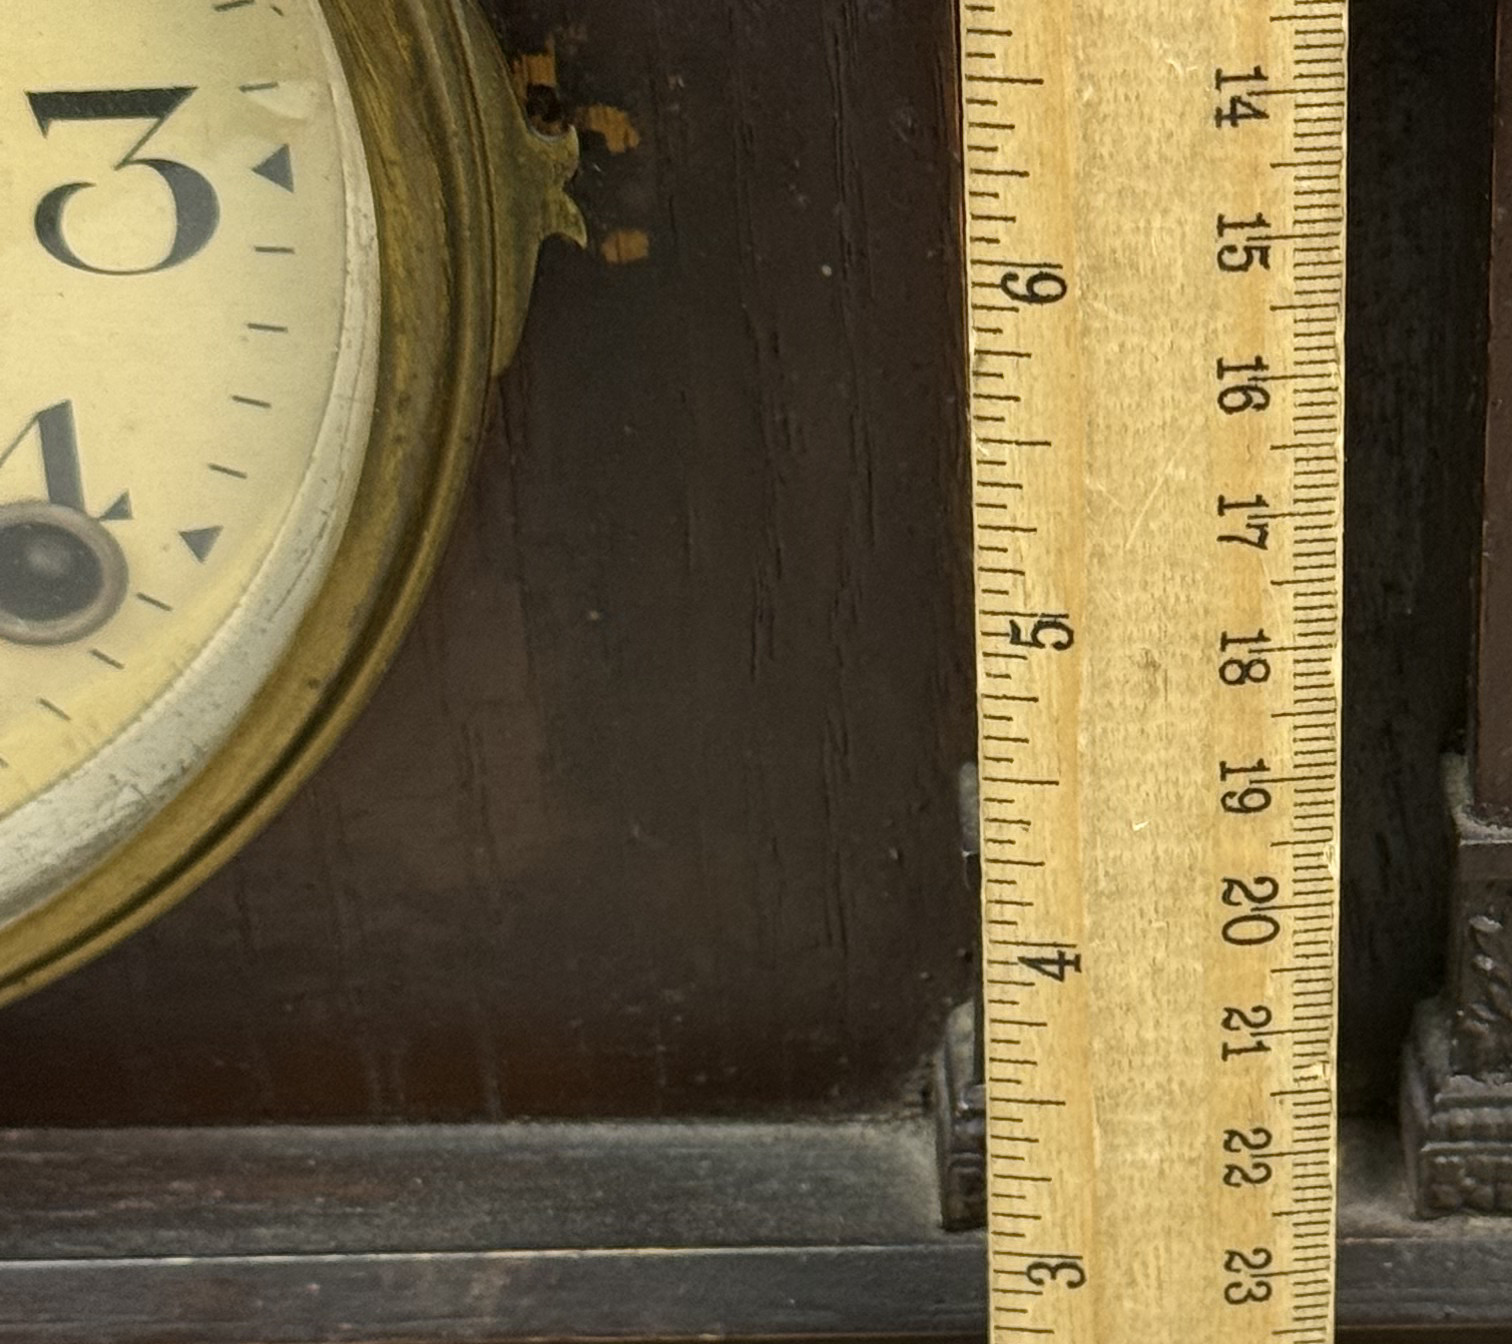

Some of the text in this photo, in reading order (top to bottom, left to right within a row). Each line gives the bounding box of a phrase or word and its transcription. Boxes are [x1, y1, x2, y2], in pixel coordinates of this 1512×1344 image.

[1214, 65, 1269, 129] 14
[25, 84, 221, 277] 3
[1216, 212, 1271, 274] 15
[1000, 269, 1067, 305] 6
[1216, 355, 1271, 416] 16
[1216, 493, 1270, 551] 17
[1008, 613, 1075, 652] 5
[1218, 628, 1271, 687] 18
[1219, 758, 1272, 815] 19
[1221, 875, 1280, 946] 20
[1016, 948, 1082, 983] 4
[1220, 1004, 1273, 1062] 21
[1222, 1126, 1273, 1188] 22
[1025, 1261, 1087, 1290] 3
[1223, 1247, 1273, 1306] 23
